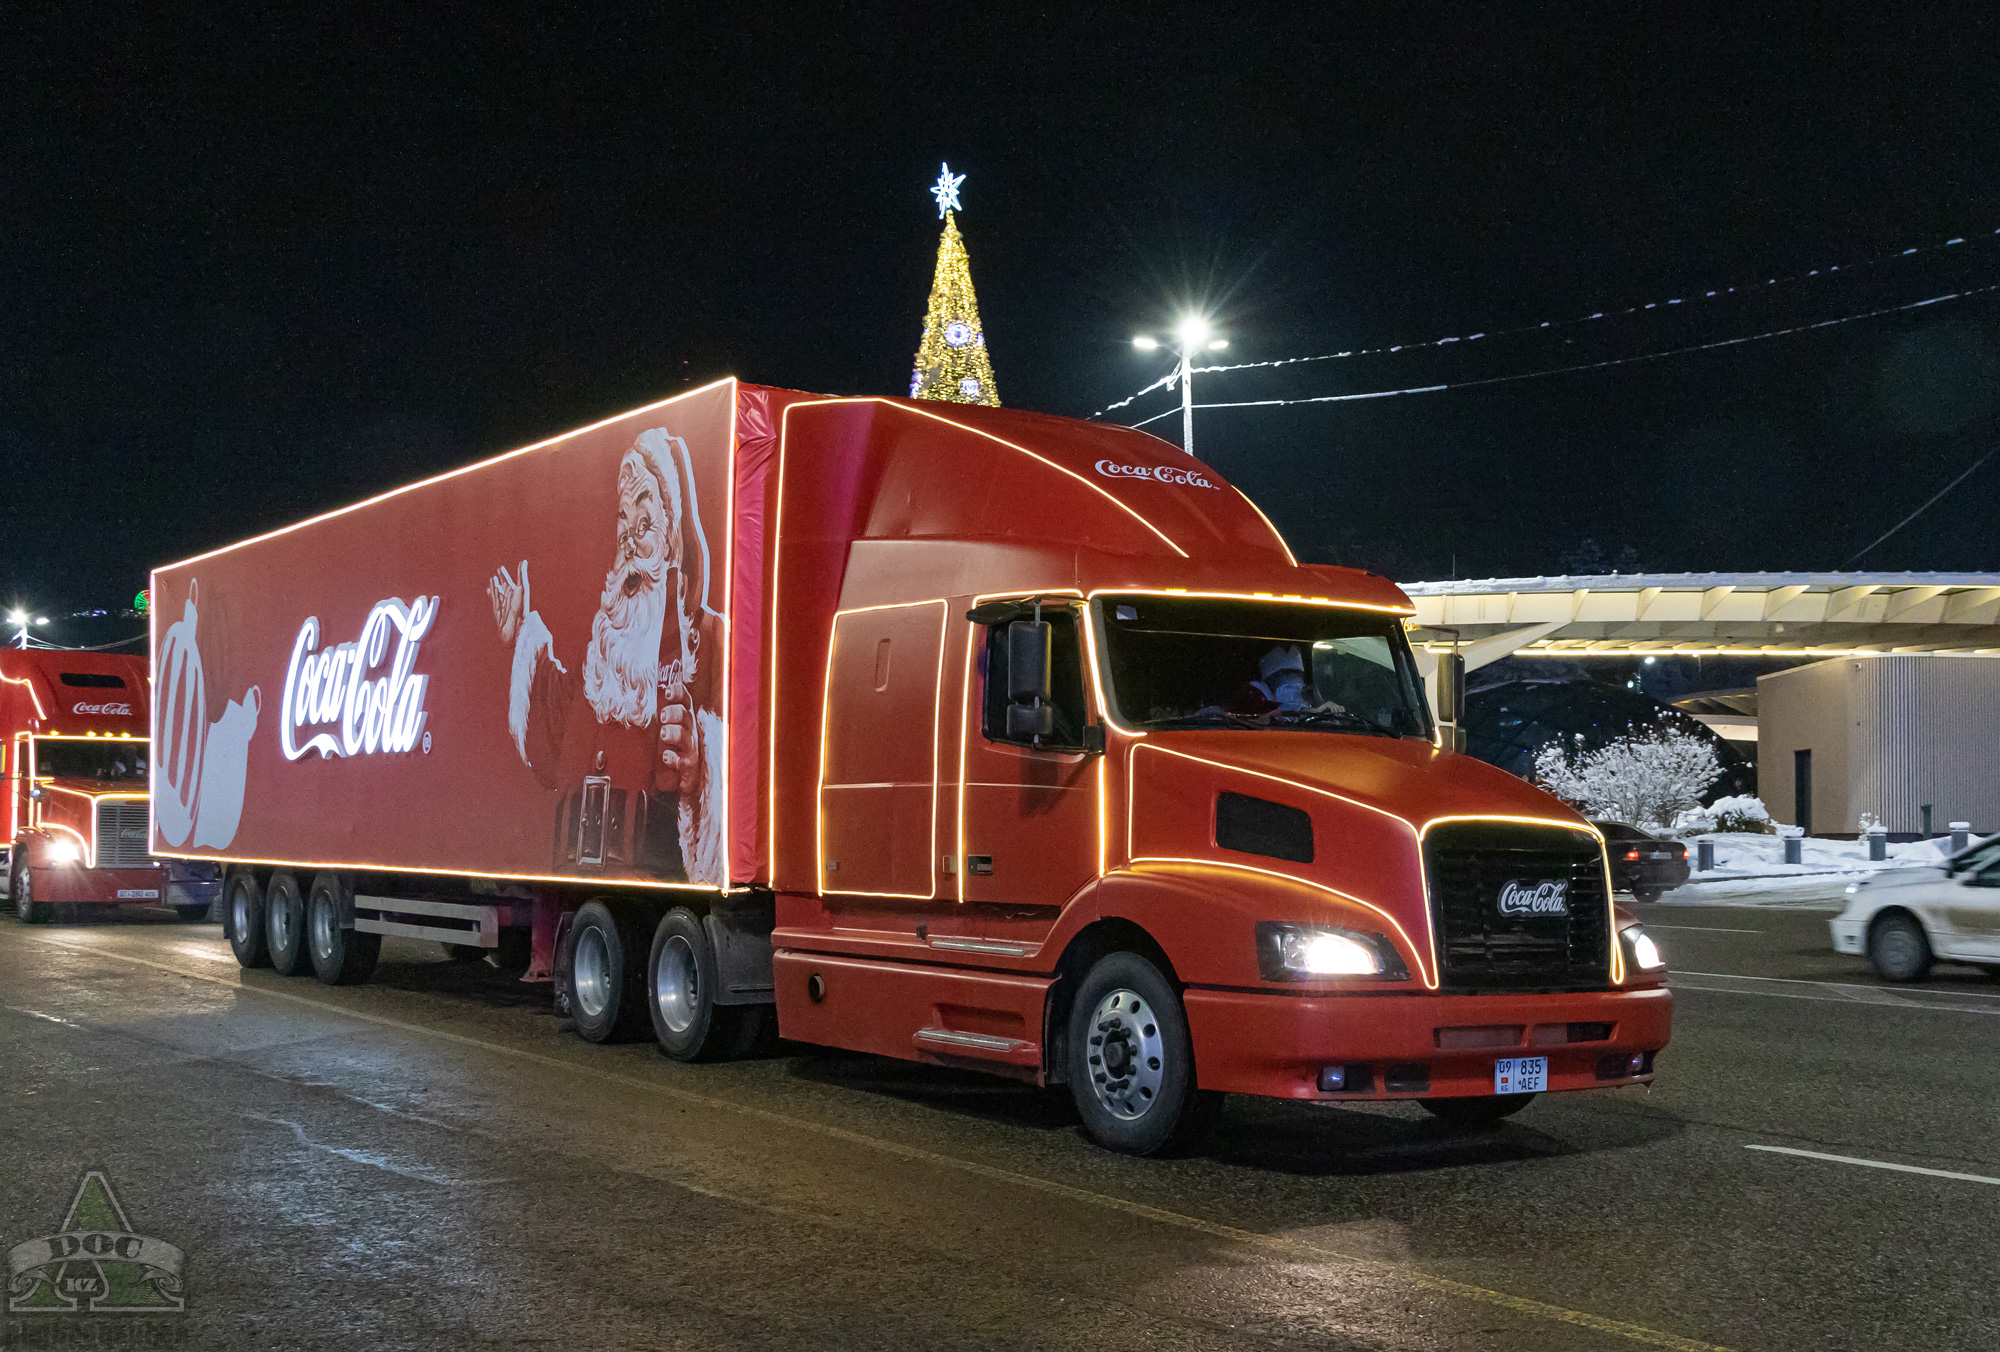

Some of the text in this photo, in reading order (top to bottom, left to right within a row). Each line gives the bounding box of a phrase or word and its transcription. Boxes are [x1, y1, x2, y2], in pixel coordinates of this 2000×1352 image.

[1095, 459, 1212, 488] Coca-Cola
[281, 595, 439, 761] Coca-Cola
[73, 702, 131, 715] Coca-Cola
[1501, 883, 1565, 913] Coca-Cola
[1520, 1059, 1541, 1075] 835
[1520, 1076, 1540, 1091] AEF
